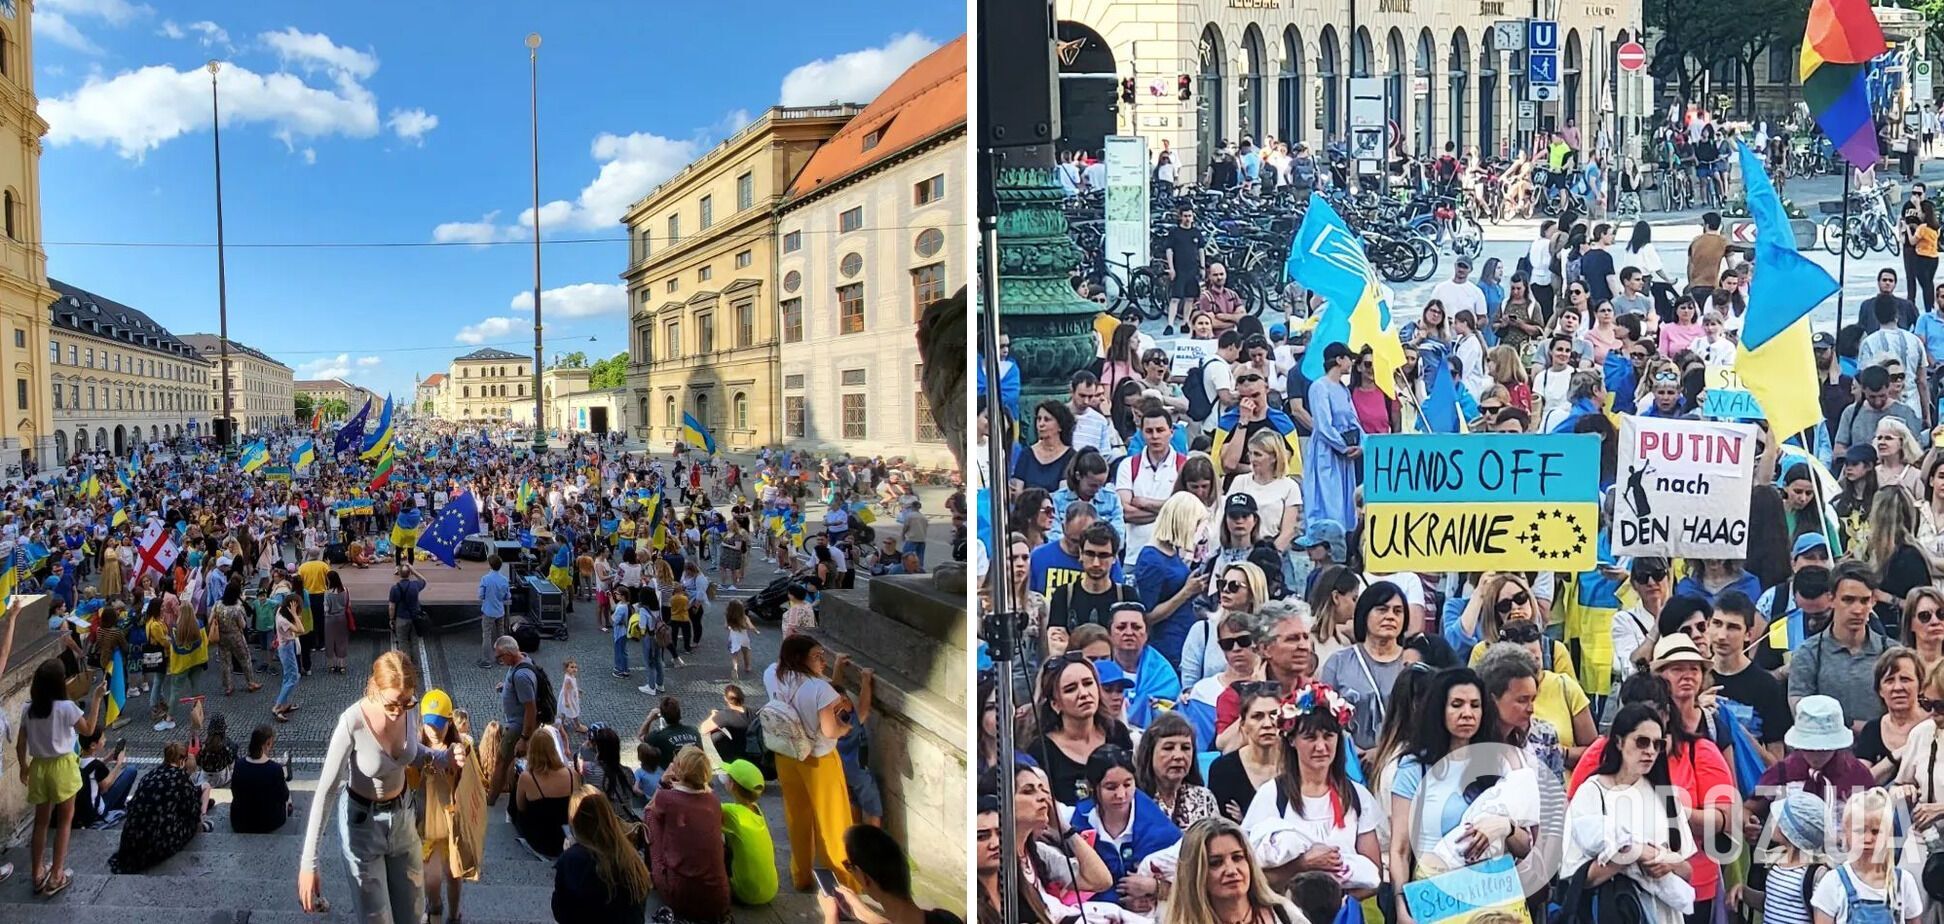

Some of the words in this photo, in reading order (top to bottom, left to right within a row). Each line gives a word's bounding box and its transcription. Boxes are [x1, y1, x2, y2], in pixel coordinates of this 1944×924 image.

[1535, 25, 1552, 46] U
[1640, 431, 1742, 465] PUTIN
[1375, 446, 1464, 494] HANDS
[1478, 449, 1564, 496] OFF
[1656, 473, 1710, 495] nach
[1370, 511, 1514, 559] UKRAINE
[1620, 515, 1670, 547] DEN
[1680, 515, 1747, 546] HAAG
[1419, 889, 1463, 918] Stop
[1469, 875, 1513, 902] killing
